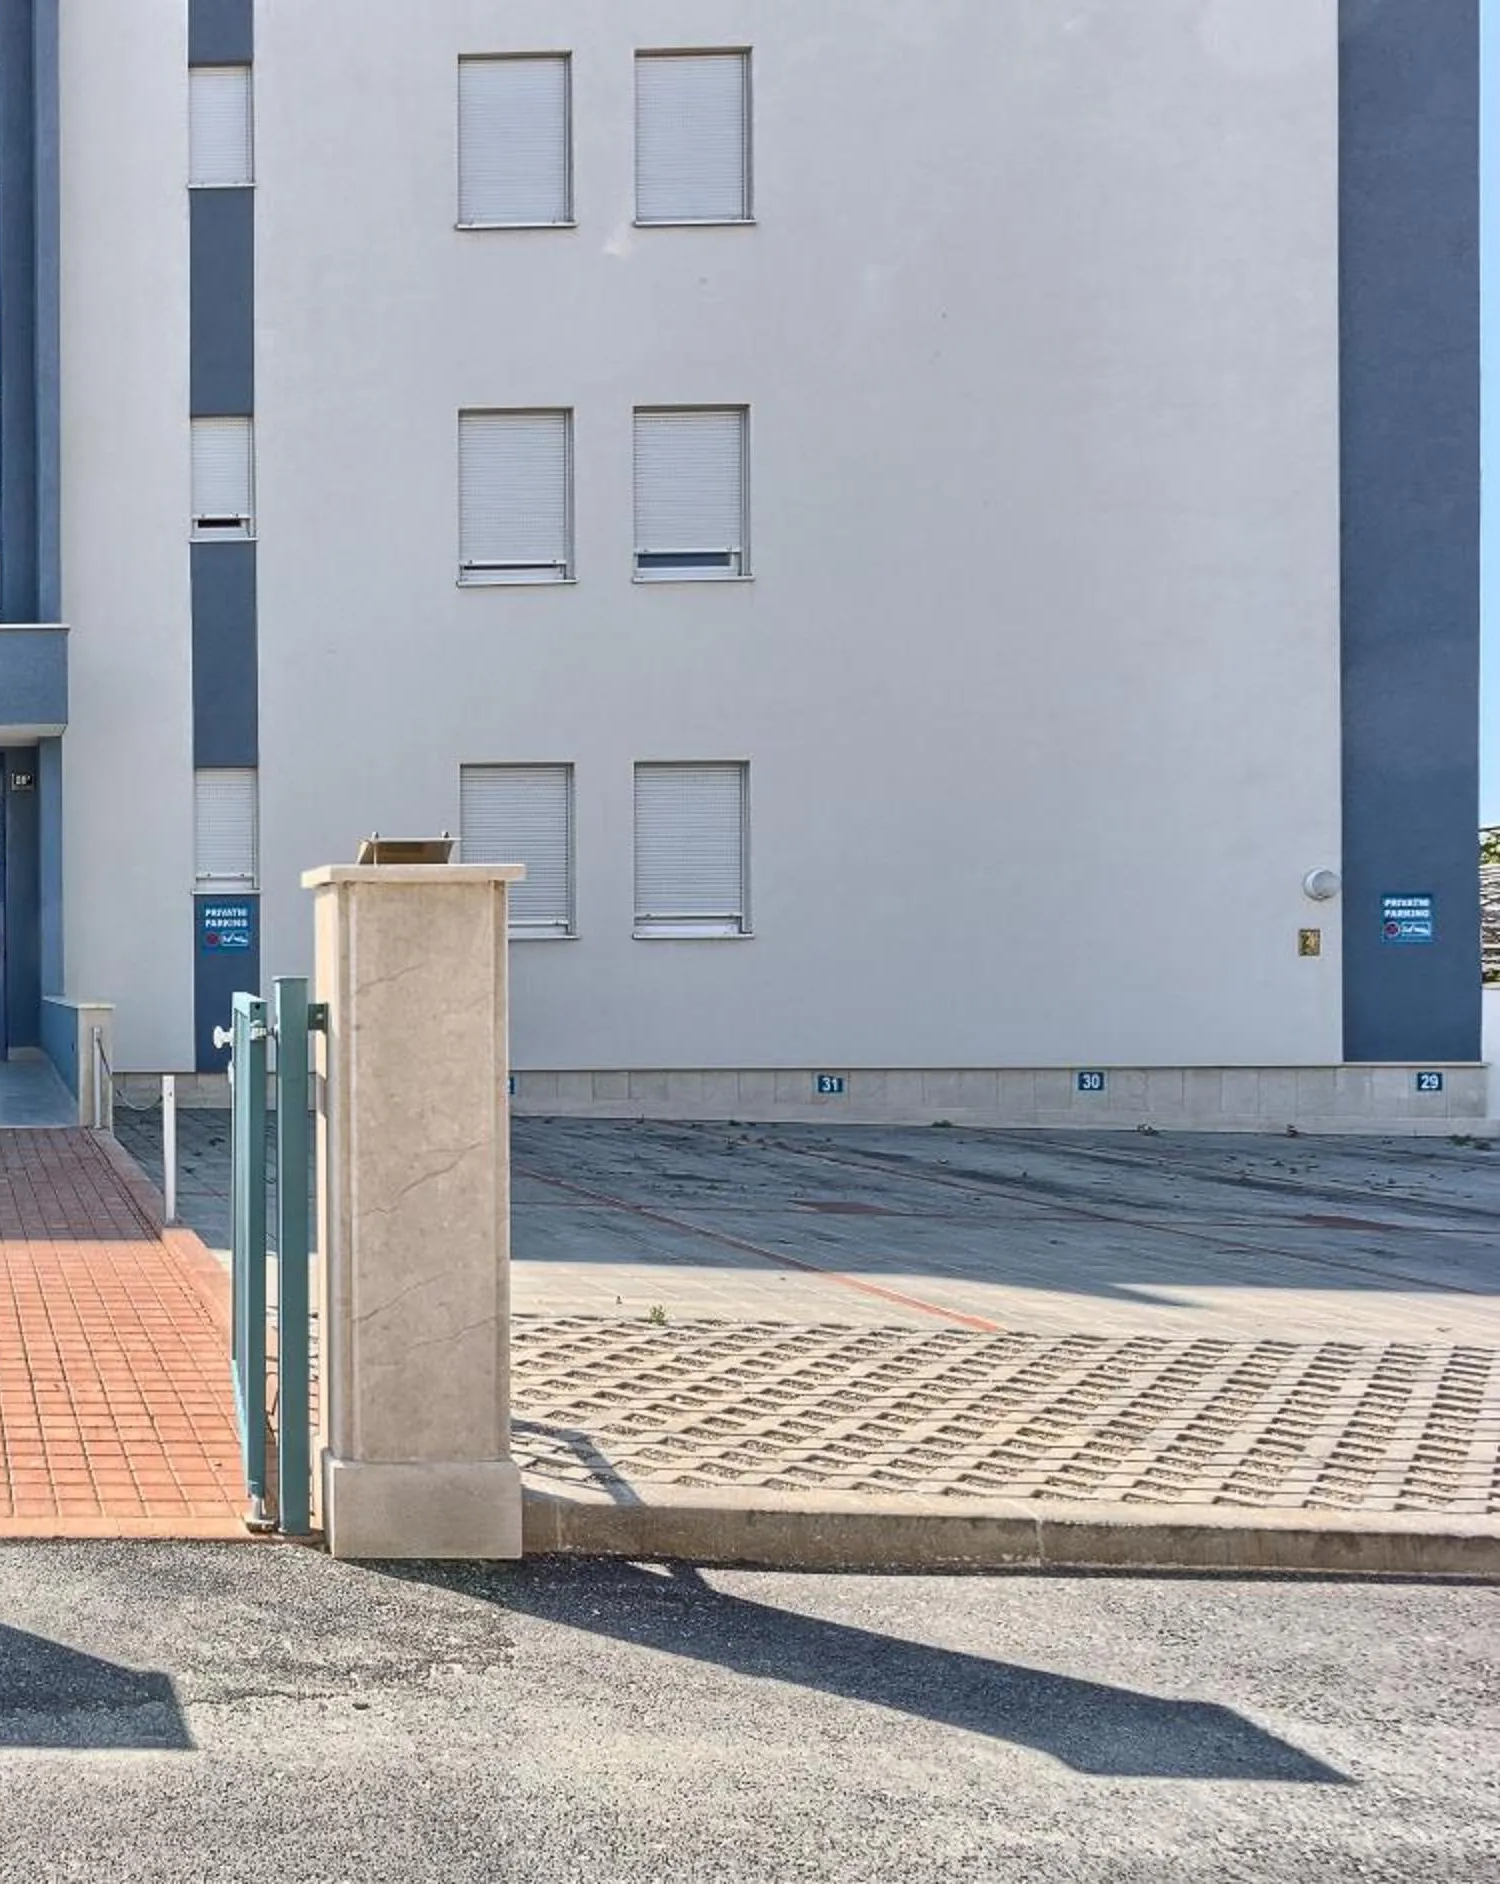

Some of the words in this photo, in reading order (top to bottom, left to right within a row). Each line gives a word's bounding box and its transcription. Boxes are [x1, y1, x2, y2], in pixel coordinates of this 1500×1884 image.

[1384, 909, 1430, 918] PARKING
[205, 919, 248, 928] PARKING
[821, 1077, 837, 1091] 31
[1083, 1074, 1100, 1089] 30
[1420, 1074, 1439, 1089] 29
